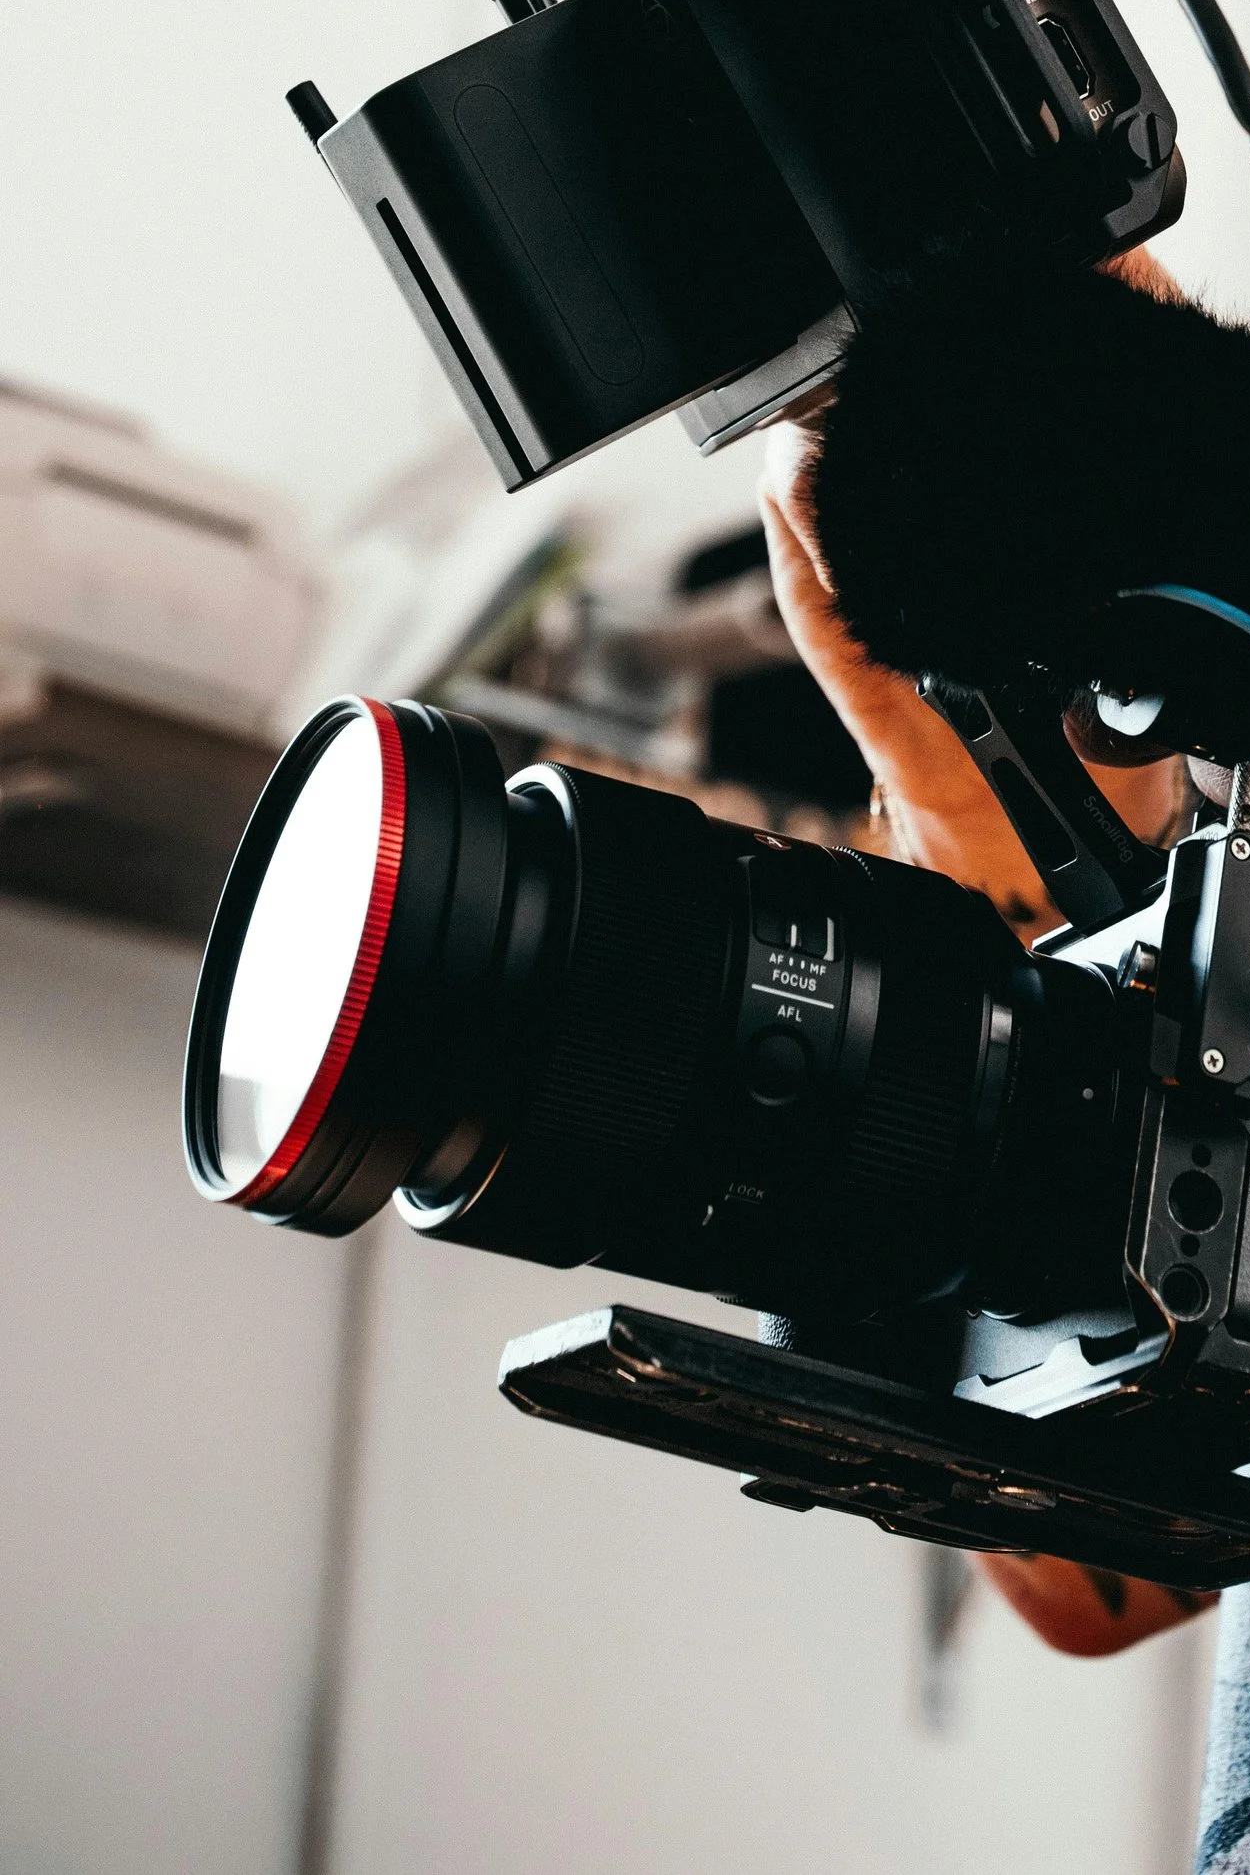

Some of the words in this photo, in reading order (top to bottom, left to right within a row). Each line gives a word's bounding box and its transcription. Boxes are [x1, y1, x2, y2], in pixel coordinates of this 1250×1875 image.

[1089, 99, 1116, 122] OUT
[769, 953, 784, 966] AF
[809, 963, 827, 976] MF
[772, 969, 817, 992] FOCUS
[777, 1005, 803, 1023] AFL
[728, 1182, 766, 1200] LOCK
